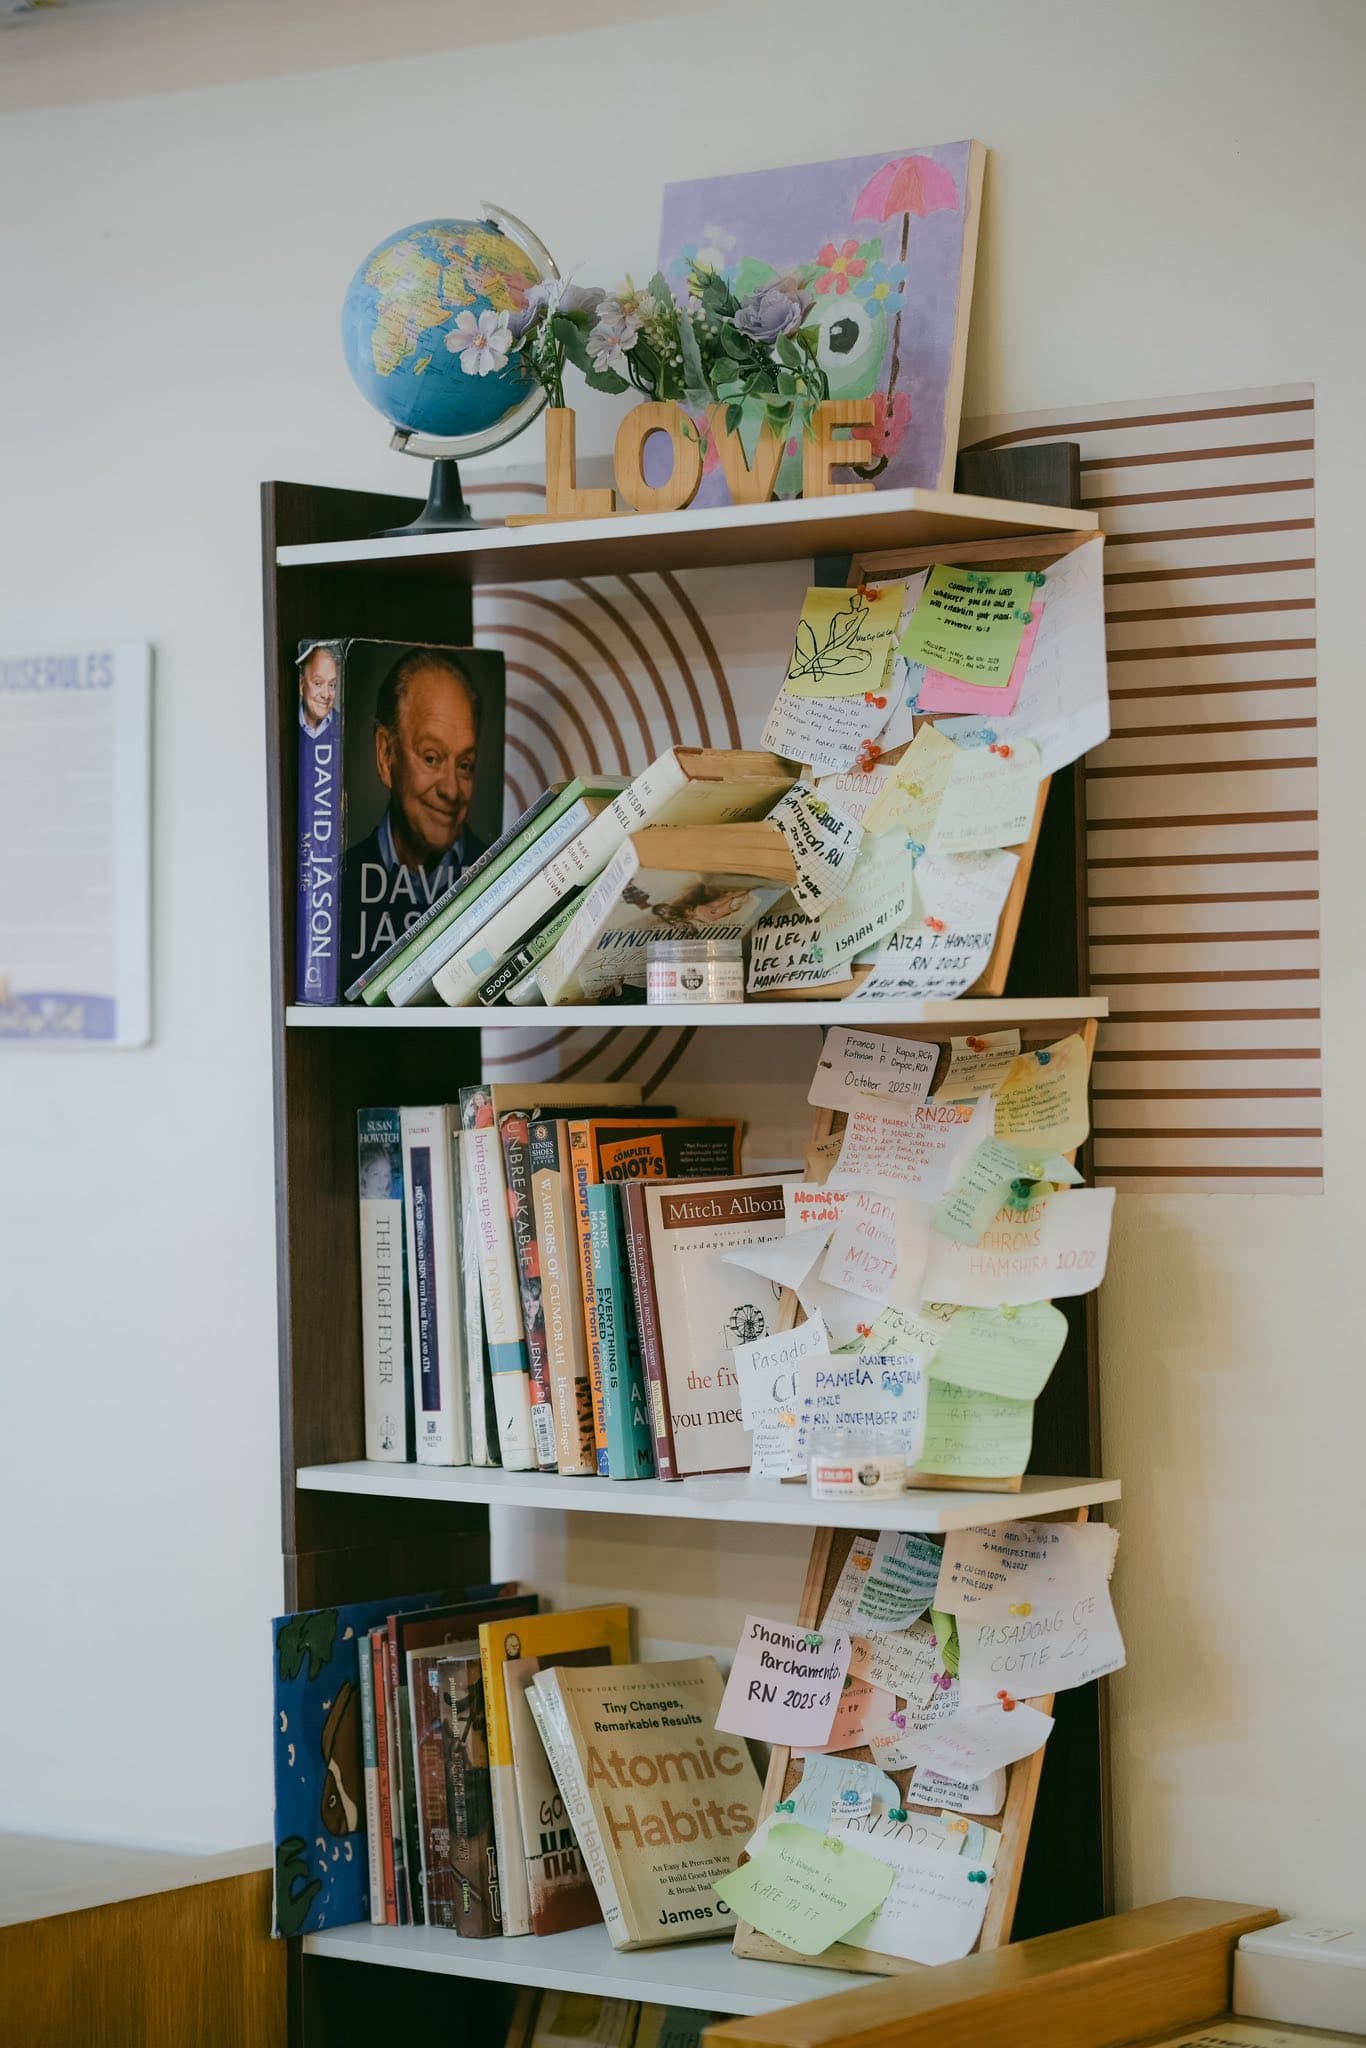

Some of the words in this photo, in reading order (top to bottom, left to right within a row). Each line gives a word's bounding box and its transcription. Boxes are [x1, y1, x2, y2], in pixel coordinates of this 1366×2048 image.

[545, 401, 875, 514] LOVE
[313, 744, 332, 842] DAVID
[457, 849, 493, 885] LOGIC
[361, 862, 466, 905] DAVI
[311, 850, 332, 958] JASON
[836, 923, 873, 952] ISAIAH
[844, 1071, 880, 1091] October
[360, 1133, 400, 1144] HOWATCH
[367, 1121, 392, 1132] SUSAN
[531, 1141, 554, 1150] TENNIS
[532, 1148, 554, 1156] SHOES
[613, 1146, 651, 1163] COMPLETE
[474, 1135, 491, 1195] bringing
[480, 1199, 492, 1216] up
[506, 1121, 532, 1266] UNBREAKABLE
[539, 1177, 556, 1254] WARRIORS
[669, 1201, 722, 1221] Mitch
[375, 1217, 390, 1258] THE
[482, 1221, 497, 1249] girls
[589, 1210, 601, 1269] MANSON
[597, 1210, 608, 1248] MARK
[634, 1232, 643, 1245] the
[636, 1246, 645, 1261] five
[673, 1239, 725, 1252] Tuesdays
[728, 1237, 753, 1248] with
[547, 1258, 558, 1280] OF
[580, 1232, 596, 1303] Recovering
[637, 1262, 648, 1288] people
[377, 1265, 391, 1317] HIGH
[640, 1289, 649, 1305] you
[548, 1283, 565, 1364] CUMORAH
[587, 1307, 598, 1338] from
[643, 1306, 652, 1326] meet
[603, 1287, 617, 1373] EVERYTHING
[610, 1376, 617, 1388] IS
[647, 1337, 657, 1366] heaven
[378, 1325, 392, 1384] FLYER
[589, 1341, 603, 1392] Identity
[687, 1370, 712, 1391] the
[716, 1367, 739, 1388] fiv
[595, 1396, 608, 1433] Theft
[672, 1410, 702, 1434] you
[707, 1408, 743, 1424] mee
[814, 1412, 829, 1425] RN
[836, 1413, 898, 1426] NOVEMBER
[602, 1701, 627, 1715] Tiny
[630, 1698, 684, 1713] Changes,
[748, 1680, 777, 1703] RN
[783, 1690, 816, 1709] 2025
[594, 1717, 660, 1733] Remarkable
[662, 1715, 702, 1729] Results
[587, 1737, 744, 1789] Atomic
[554, 1741, 590, 1815] Atomic
[578, 1818, 611, 1887] Habits
[604, 1799, 755, 1850] Habits
[652, 1864, 662, 1873] An
[663, 1862, 680, 1874] Easy
[688, 1858, 713, 1868] Proven
[714, 1854, 730, 1866] Way
[659, 1876, 667, 1885] to
[668, 1873, 686, 1884] Build
[687, 1870, 706, 1881] Good
[708, 1867, 731, 1878] Habits
[676, 1884, 696, 1895] Break
[659, 1903, 713, 1926] James
